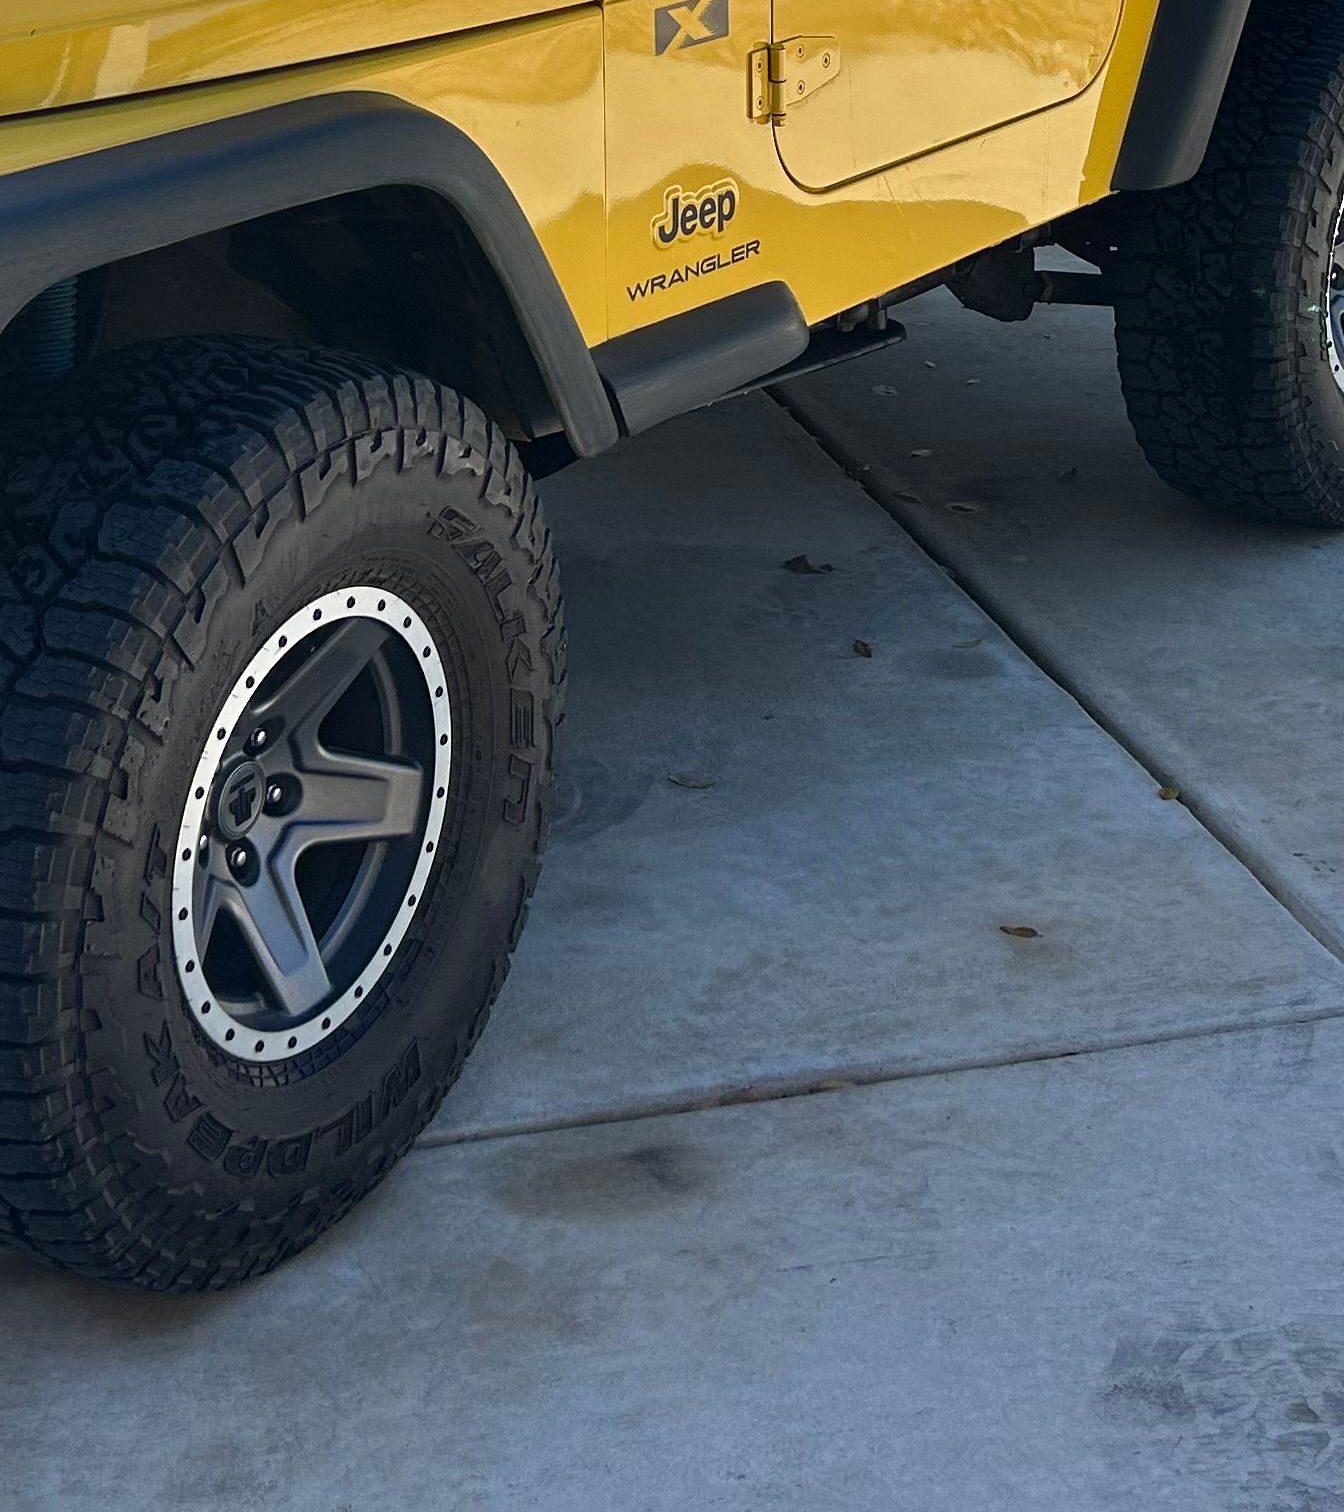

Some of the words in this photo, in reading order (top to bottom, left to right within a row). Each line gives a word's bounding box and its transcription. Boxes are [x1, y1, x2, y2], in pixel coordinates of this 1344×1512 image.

[658, 190, 736, 243] Jeep
[626, 239, 761, 302] WRANGLER
[143, 1019, 423, 1179] WILDPEAK
